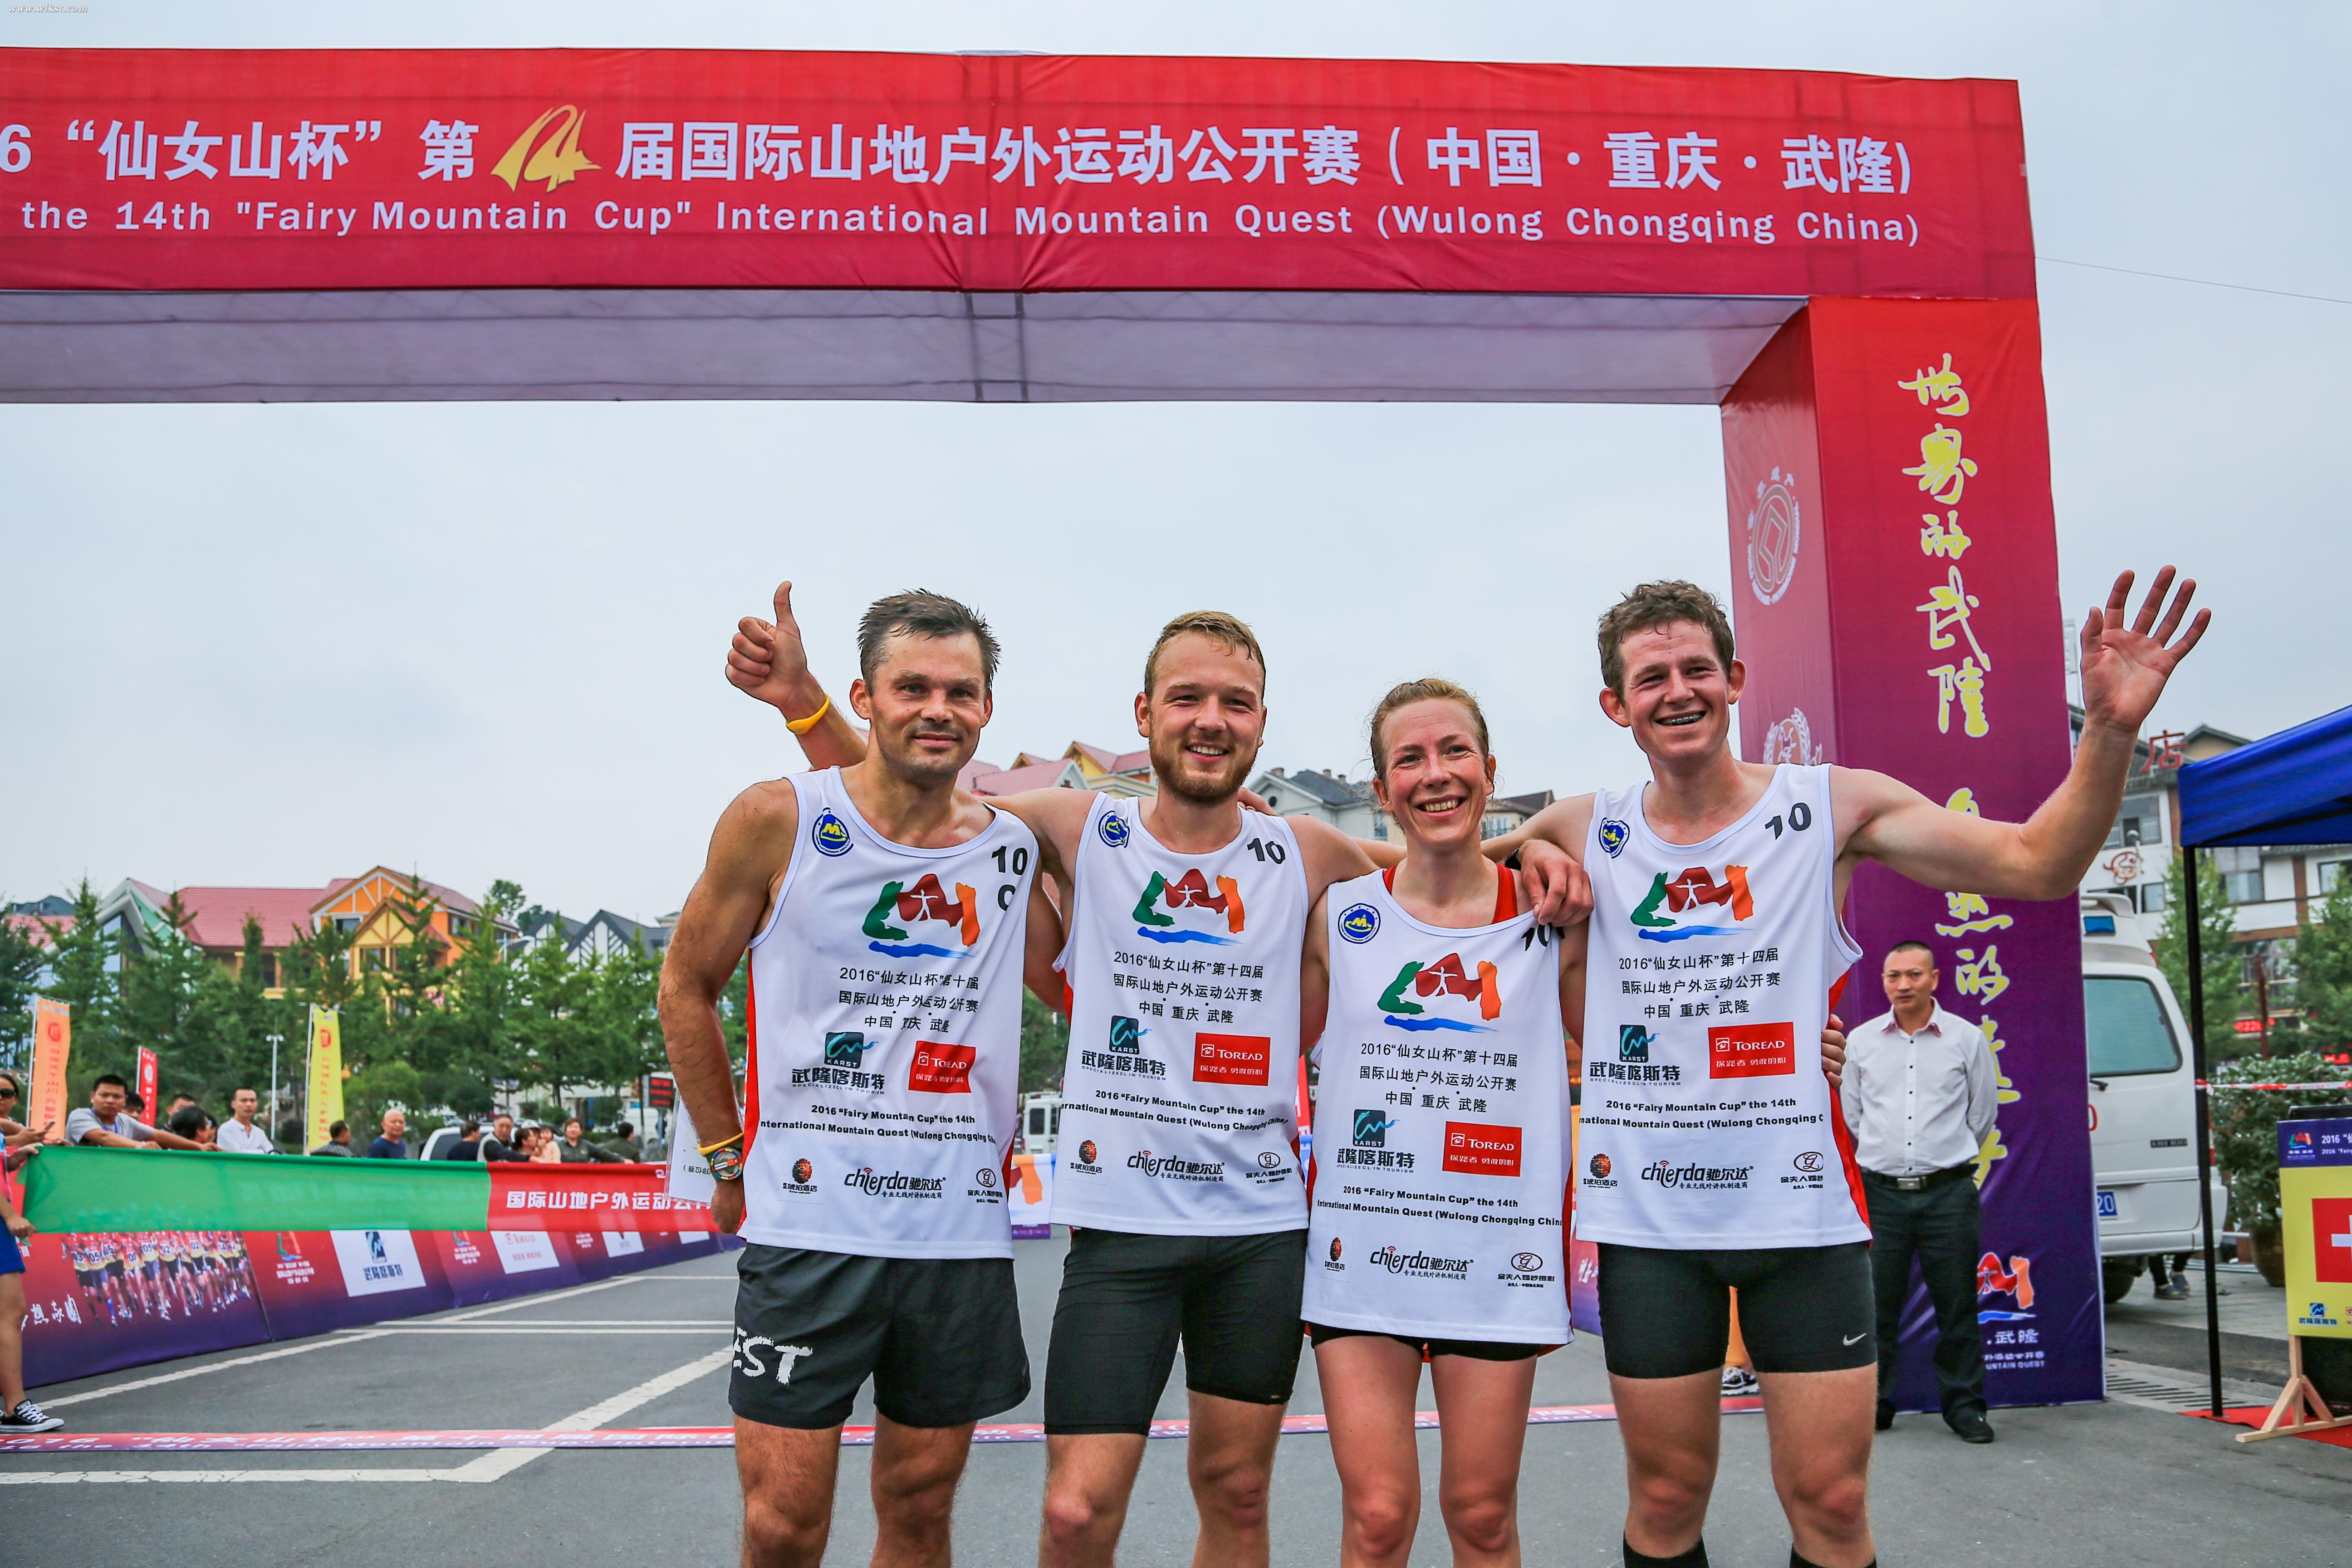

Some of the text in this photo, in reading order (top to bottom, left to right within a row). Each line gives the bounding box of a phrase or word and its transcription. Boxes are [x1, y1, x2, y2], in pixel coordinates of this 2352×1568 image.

[417, 120, 480, 181] 第
[615, 121, 1362, 187] 届国际山地户外运动公开赛
[22, 200, 1919, 247] the 14th "Fairy Mountain Cup" International Mountain Quest (Wulong Chongqing China)
[1765, 803, 1812, 840] 10
[992, 846, 1028, 875] 10
[1247, 838, 1286, 864] 10
[1114, 951, 1264, 979] 2016“仙女山杯”第十四届
[1619, 947, 1779, 970] 2016“仙女山杯”第十四届
[839, 967, 979, 990] 2016“仙女山杯”第十届
[1113, 973, 1263, 1002] 国际山地户外运动公开赛
[1622, 972, 1781, 995] 国际山地户外运动公开赛
[1216, 1049, 1263, 1061] TOREAD
[1361, 1043, 1518, 1068] 2016“仙女山杯”第十四届
[1733, 1039, 1785, 1051] TOREAD
[827, 1059, 858, 1067] KARST
[1082, 1050, 1166, 1076] 武隆喀斯特
[1589, 1062, 1681, 1081] 武隆喀斯特
[792, 1067, 885, 1090] 武隆喀斯特
[1360, 1065, 1517, 1092] 国际山地户外运动公开赛
[811, 1105, 836, 1115] 2016
[871, 1112, 914, 1122] Mountan
[956, 1115, 975, 1124] 14th
[1095, 1090, 1119, 1100] 2016
[1152, 1097, 1197, 1111] Mountain
[1227, 1106, 1244, 1115] the
[1247, 1108, 1265, 1116] 14th
[1606, 1100, 1631, 1111] 2016
[1666, 1103, 1716, 1112] Mountain
[1749, 1100, 1768, 1108] the
[1770, 1098, 1796, 1107] 14th
[1061, 1103, 1107, 1115] ernational
[1110, 1108, 1154, 1121] Mountain
[1156, 1114, 1187, 1124] Quest
[1190, 1118, 1230, 1131] (Wulong
[1233, 1121, 1268, 1131] Chongqing
[1623, 1119, 1670, 1128] Mountain
[1672, 1120, 1704, 1129] Quest
[1707, 1119, 1753, 1130] (Wulong
[1756, 1115, 1816, 1126] Chongqing
[760, 1120, 825, 1131] nternational
[828, 1124, 874, 1136] Mountain
[877, 1128, 908, 1137] Quest
[945, 1132, 986, 1142] Chongqing
[2322, 1135, 2340, 1144] 2016
[1467, 1138, 1514, 1151] TOREAD
[1127, 1150, 1186, 1177] chierda
[1337, 1148, 1415, 1169] 武隆喀斯特
[844, 1167, 909, 1196] chierda
[1641, 1160, 1705, 1188] chierda
[1780, 1175, 1823, 1183] 金夫人婚纱
[1343, 1186, 1362, 1195] 2016
[1397, 1191, 1445, 1202] Mountain
[1477, 1198, 1494, 1206] the
[1497, 1199, 1518, 1207] 14th
[1317, 1199, 1351, 1210] International
[1353, 1203, 1399, 1215] Mountain
[1402, 1208, 1433, 1217] Quest
[1436, 1210, 1479, 1223] (Wulong
[1481, 1215, 1535, 1226] Chongqing
[1370, 1246, 1430, 1274] chierda
